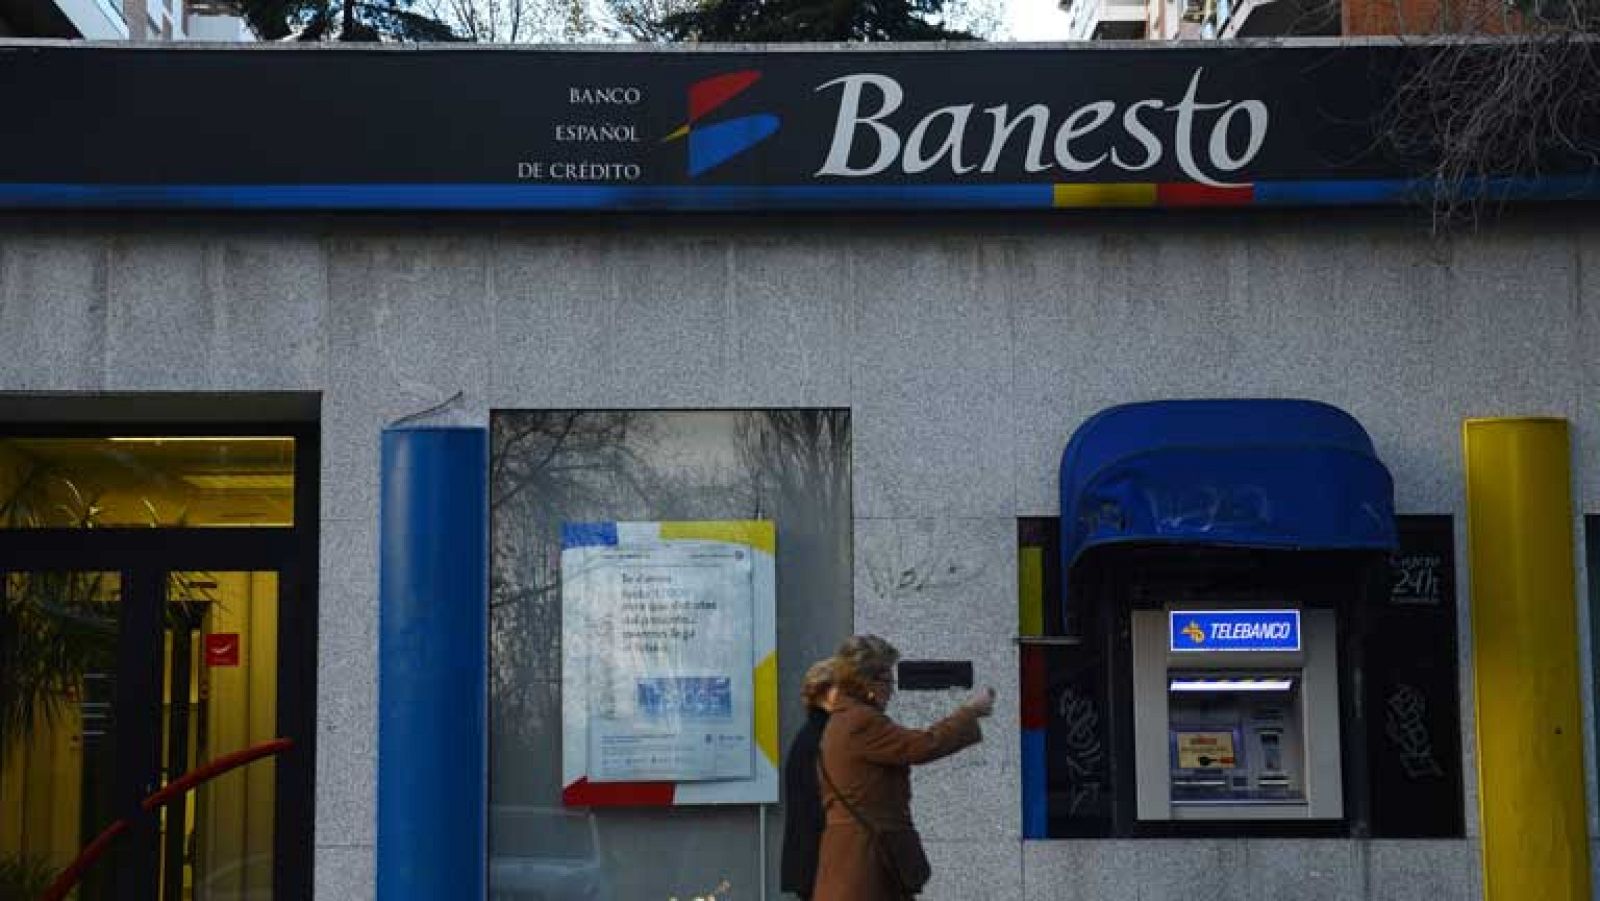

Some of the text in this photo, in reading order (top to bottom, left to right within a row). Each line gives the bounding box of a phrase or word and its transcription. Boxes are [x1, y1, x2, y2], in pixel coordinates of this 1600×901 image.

[570, 87, 641, 103] BANCO
[555, 122, 640, 142] ESPAÑOL
[814, 66, 1268, 187] Banesto
[518, 160, 641, 179] DE CRÉDITO
[1211, 623, 1291, 639] TELEBANCO
